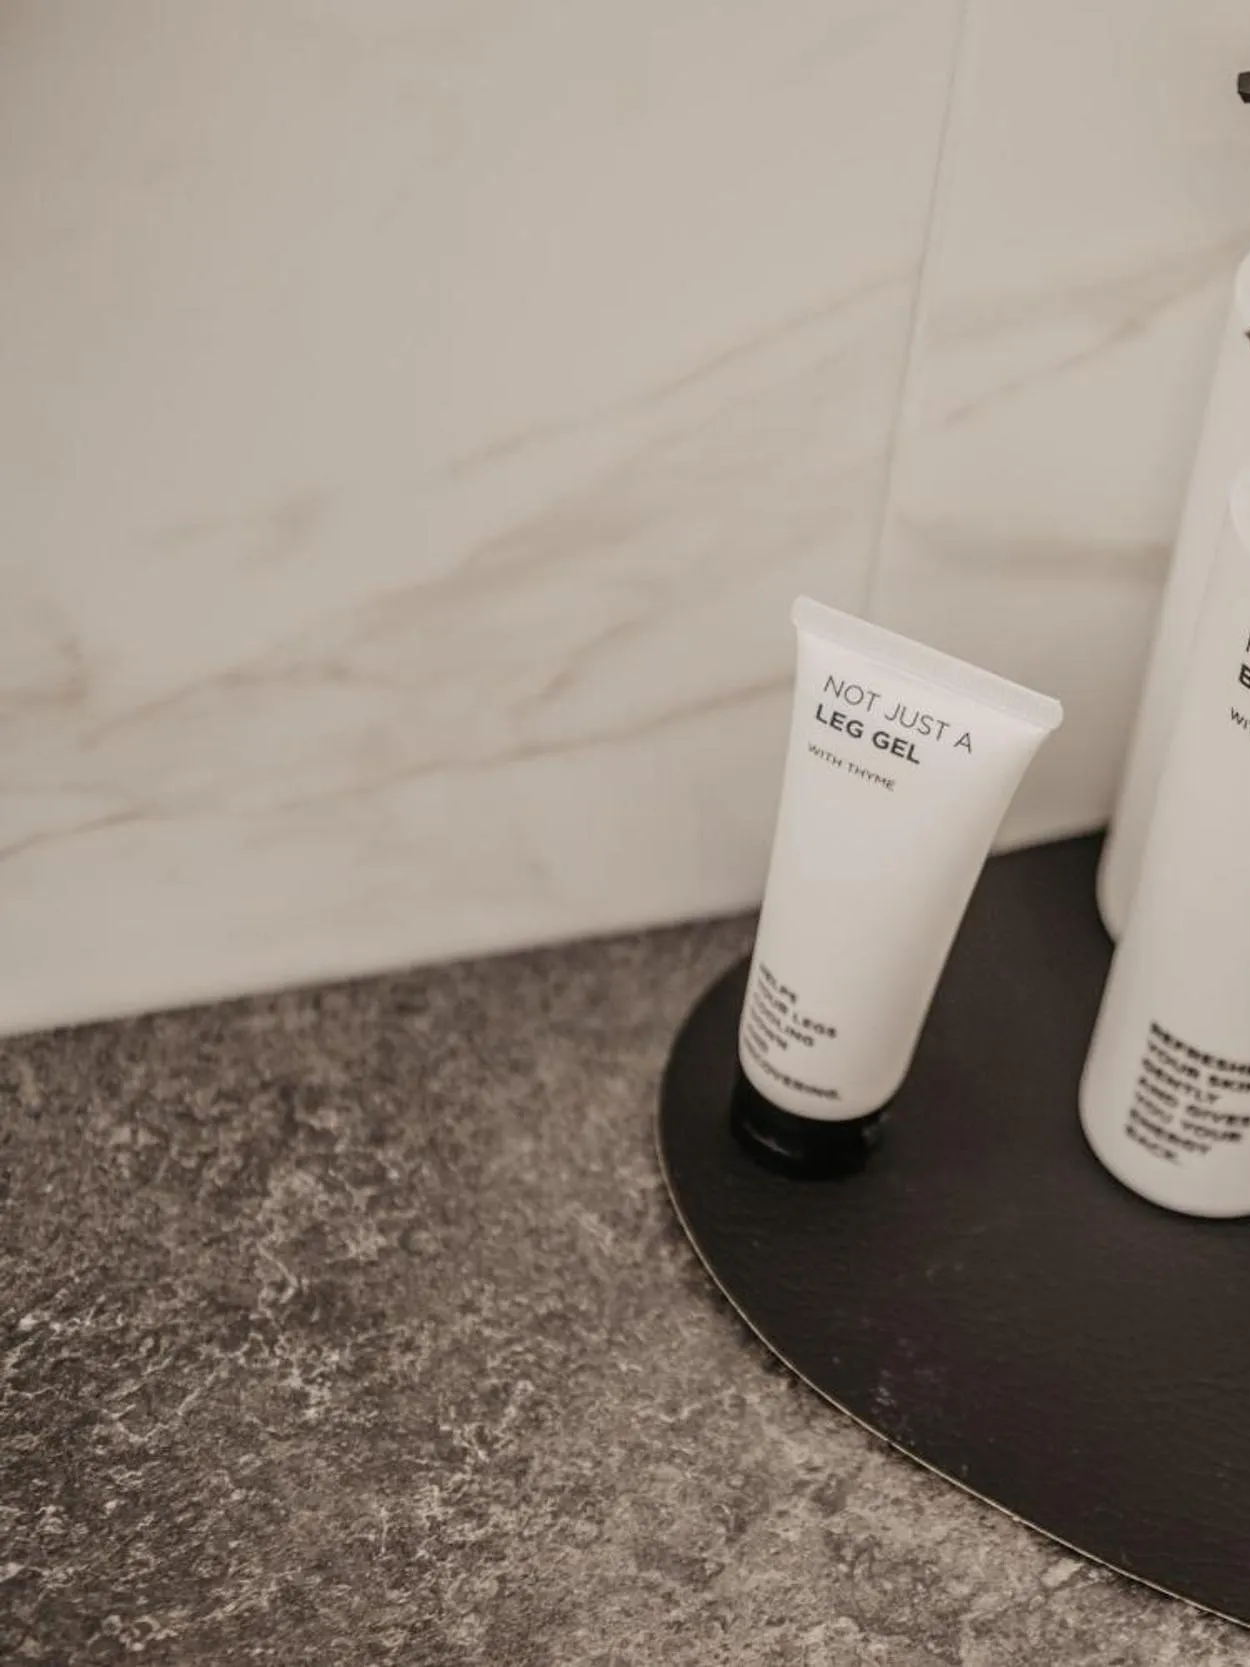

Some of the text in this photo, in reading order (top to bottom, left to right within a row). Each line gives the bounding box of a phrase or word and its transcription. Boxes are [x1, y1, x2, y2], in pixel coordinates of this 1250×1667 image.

[815, 704, 920, 765] LEG GEL
[823, 675, 973, 754] NOT JUST A
[808, 741, 896, 791] WITH THYME
[792, 1012, 837, 1039] LEGS
[1142, 1057, 1220, 1105] GENTLY
[1148, 1040, 1200, 1079] YOUR
[1138, 1075, 1179, 1108] AND
[1129, 1108, 1212, 1155] ENERGY
[1135, 1091, 1243, 1142] YOU YOUR
